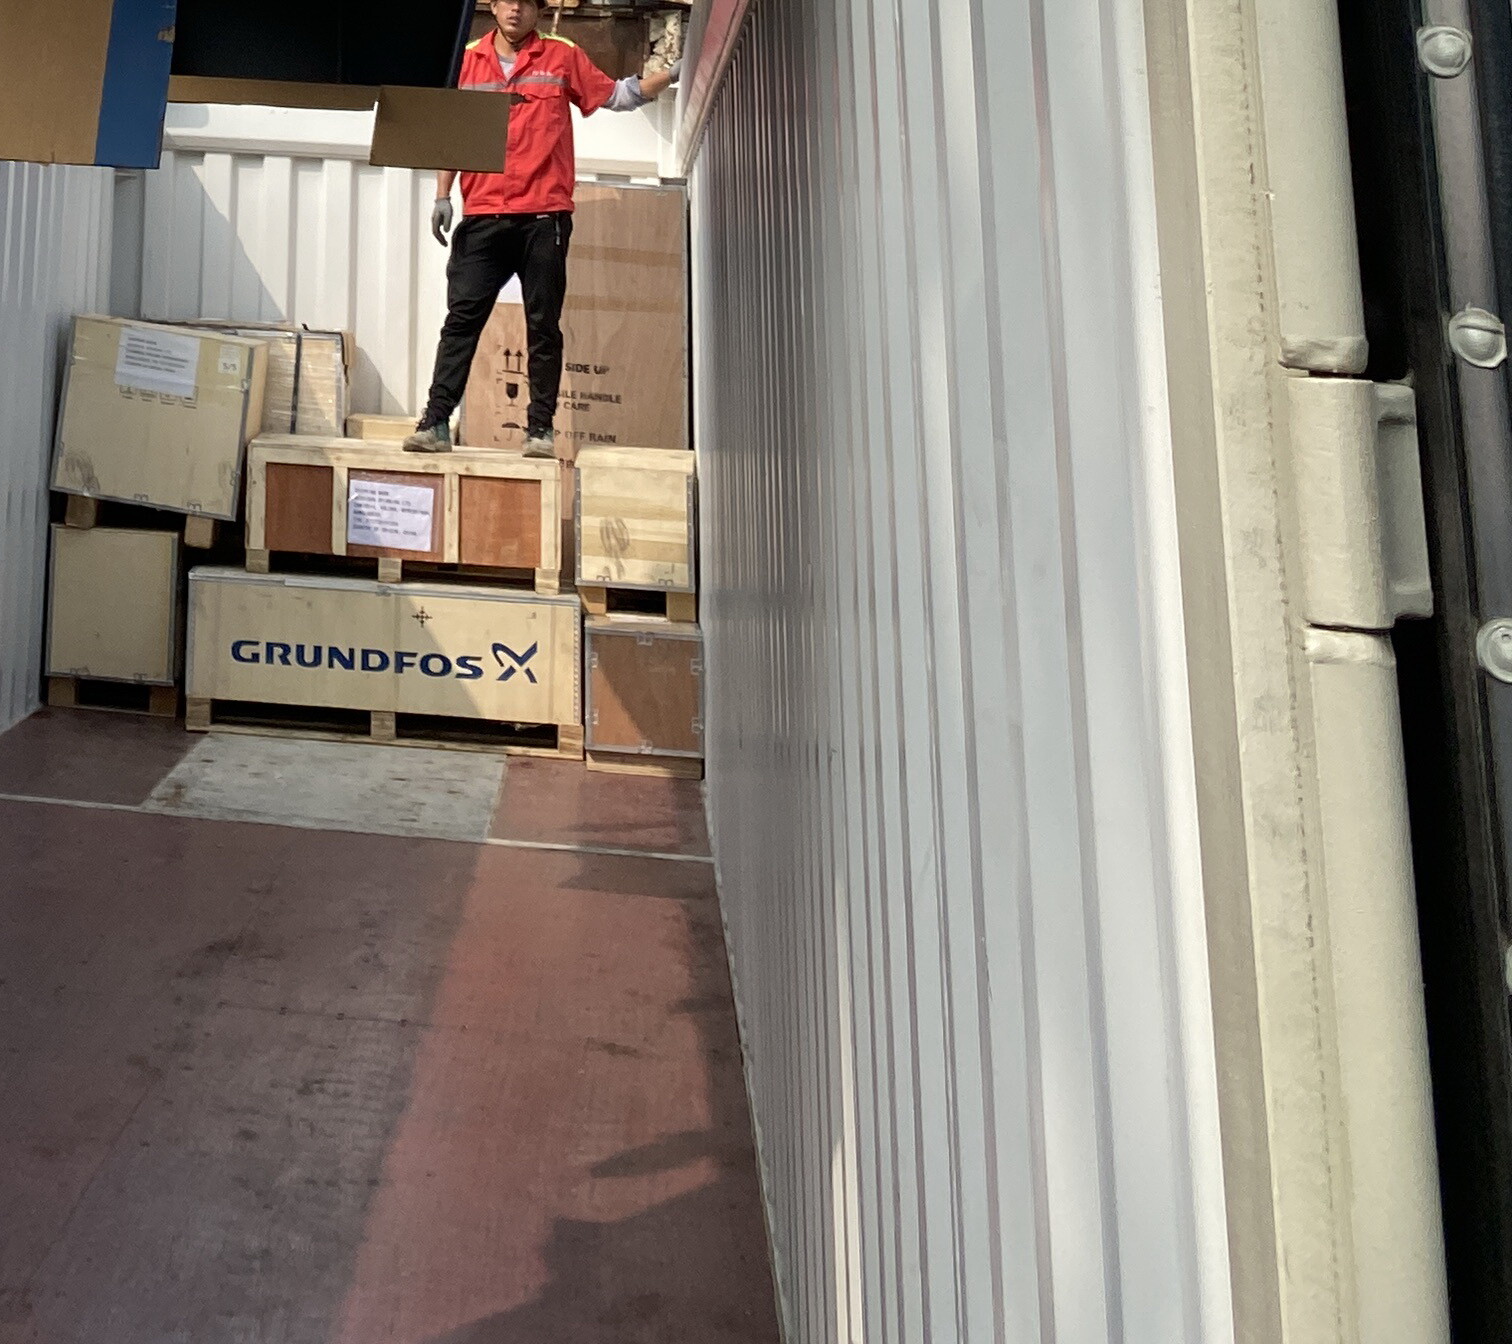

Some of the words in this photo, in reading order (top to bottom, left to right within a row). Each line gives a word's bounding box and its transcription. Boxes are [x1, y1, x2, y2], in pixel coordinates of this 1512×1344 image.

[565, 363, 590, 374] SIDE
[563, 402, 591, 411] CARE
[589, 432, 616, 443] RAIN
[231, 640, 484, 679] GRUNDFOS
